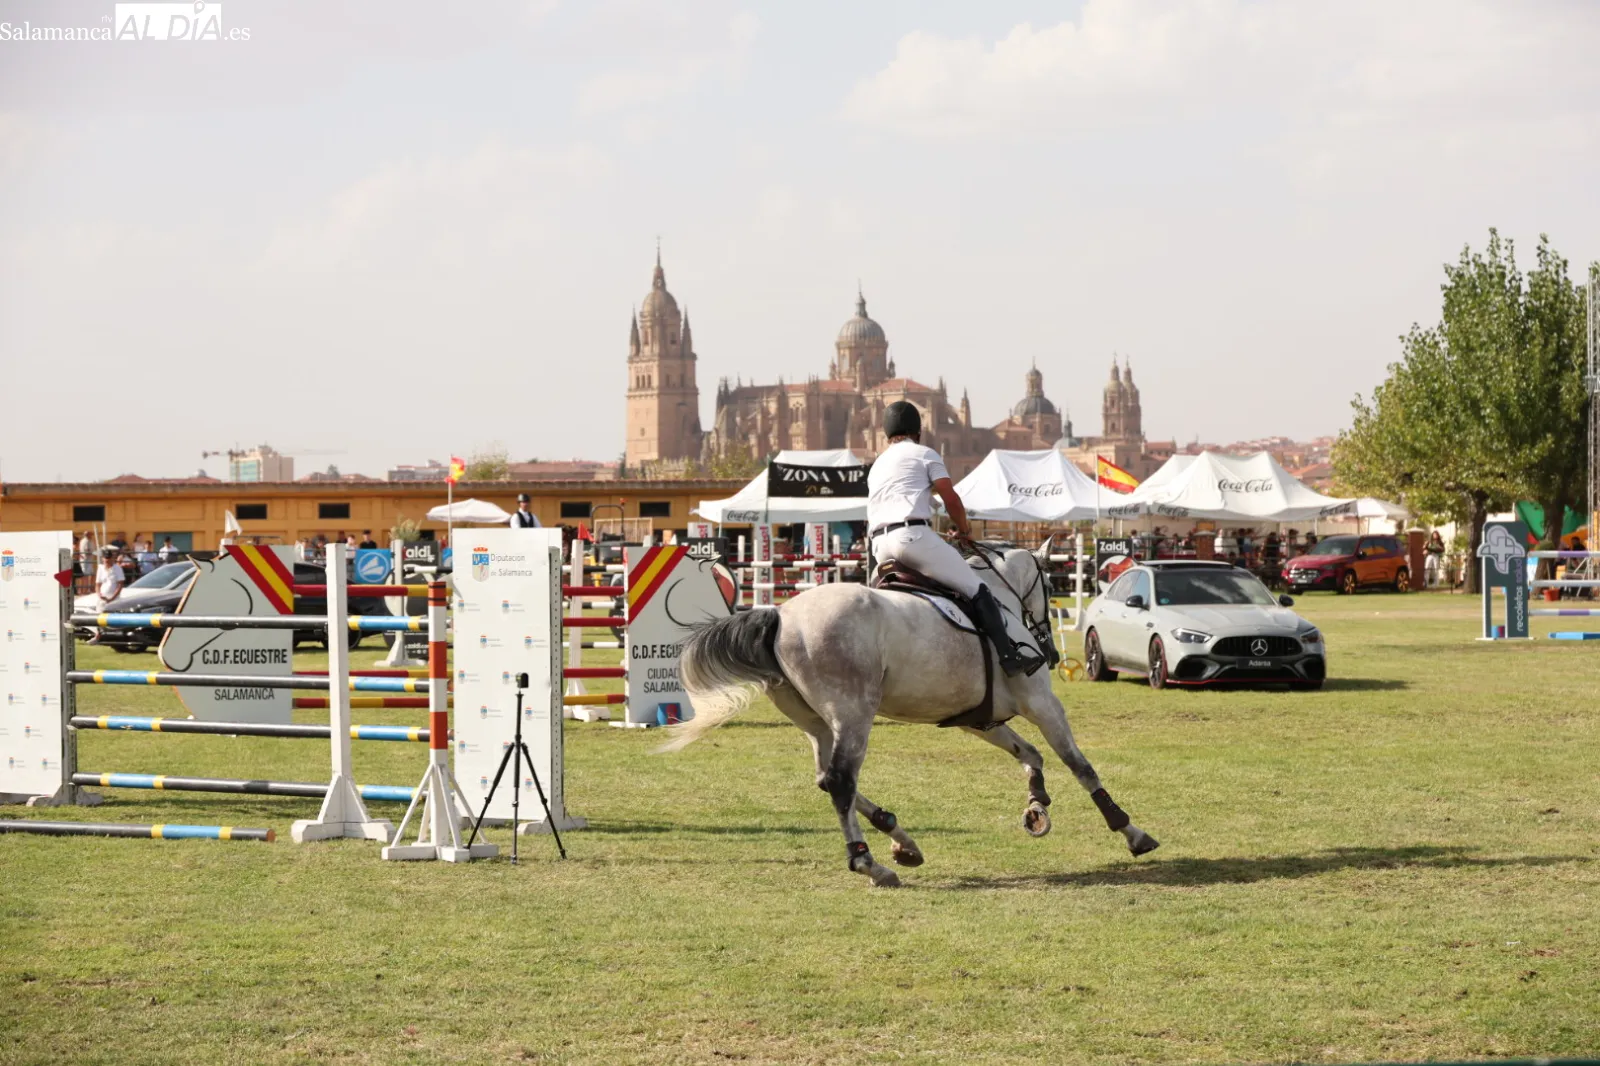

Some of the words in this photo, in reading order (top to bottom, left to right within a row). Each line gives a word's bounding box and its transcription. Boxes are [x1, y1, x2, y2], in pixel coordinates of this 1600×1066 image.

[782, 468, 830, 483] ZONA
[837, 469, 864, 483] VIP
[404, 545, 430, 558] aldi
[1514, 586, 1524, 632] recoletas
[202, 649, 288, 665] C.D.F.ECUESTRE
[214, 687, 275, 700] SALAMANCA
